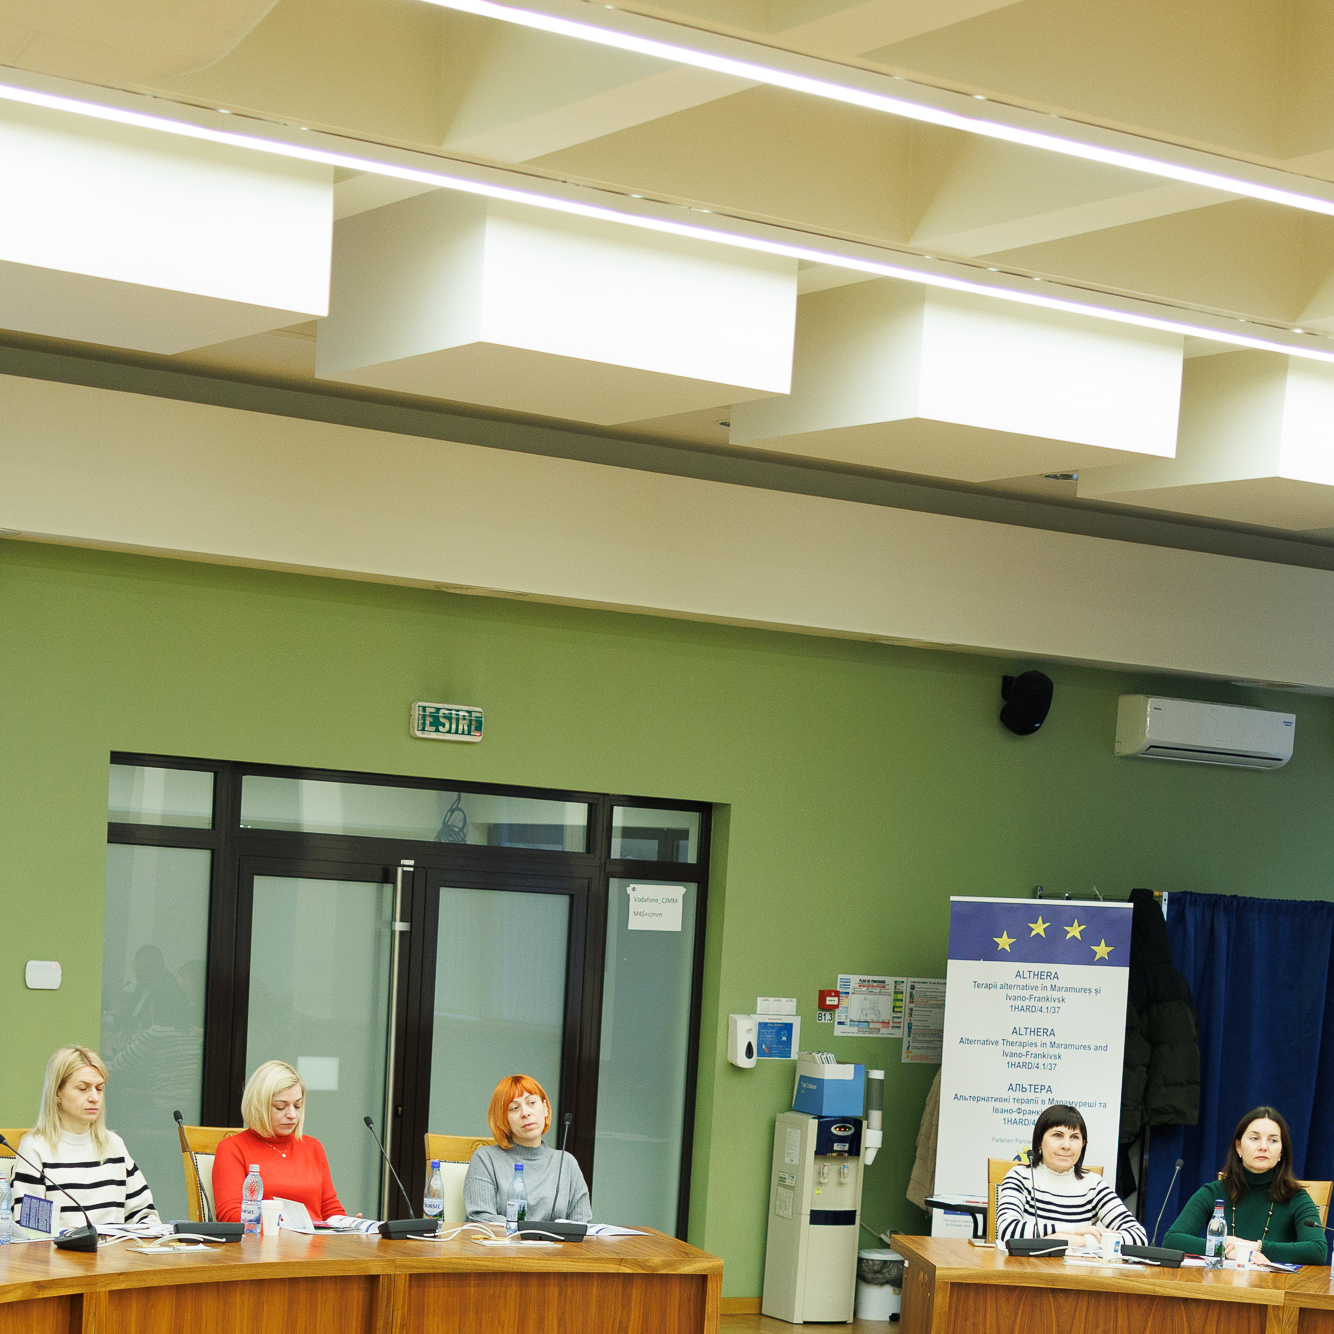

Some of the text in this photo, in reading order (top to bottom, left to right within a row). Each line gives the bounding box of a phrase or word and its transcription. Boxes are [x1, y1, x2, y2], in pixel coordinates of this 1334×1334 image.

[1014, 970, 1059, 980] ALTHERA
[973, 980, 998, 990] Terapii
[999, 982, 1039, 992] alternative
[1050, 984, 1092, 995] Maramureș
[1005, 993, 1066, 1003] Ivano-Frankivsk
[1010, 1005, 1061, 1014] 1HARD/4.1/37
[817, 1012, 833, 1021] B1.3
[1011, 1027, 1056, 1037] ALTHERA
[959, 1037, 1108, 1052] Alternative Therapies in Maramures and
[1002, 1050, 1062, 1060] Ivano-Frankivsk
[1006, 1061, 1057, 1071] 1HARD/4.1/37
[1007, 1083, 1053, 1094] АЛЬТЕРА
[953, 1093, 1011, 1104] Альтернативні
[1013, 1096, 1040, 1106] терапії
[992, 1106, 1043, 1117] Івано-Франкі
[1003, 1118, 1036, 1127] 1HARD/4
